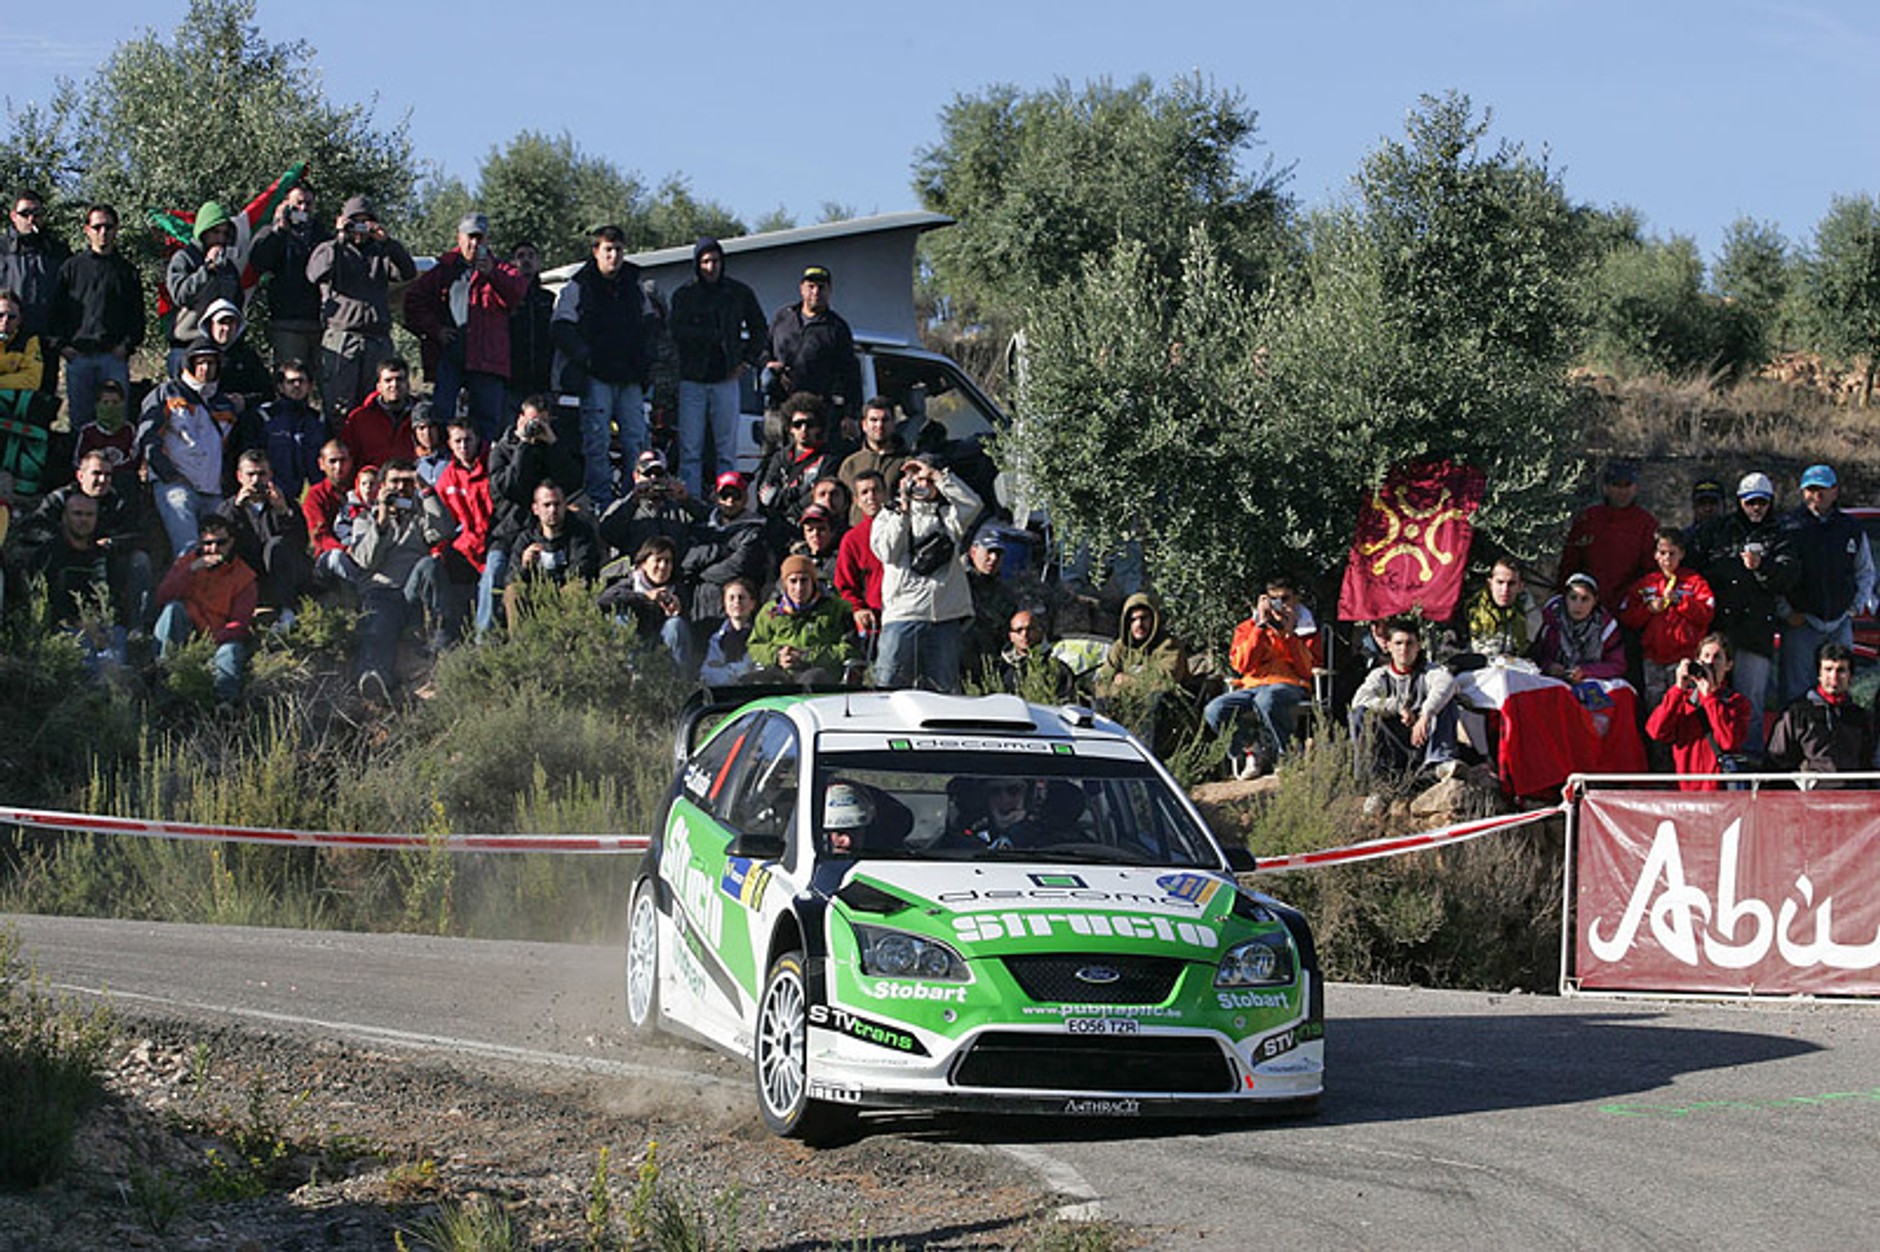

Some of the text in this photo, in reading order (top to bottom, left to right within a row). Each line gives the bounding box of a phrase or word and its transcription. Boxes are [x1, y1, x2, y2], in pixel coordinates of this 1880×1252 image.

[916, 739, 1047, 750] decoma
[873, 981, 968, 1003] Stobart
[1217, 991, 1290, 1010] Stobart
[1068, 1020, 1137, 1033] EO56 TZR
